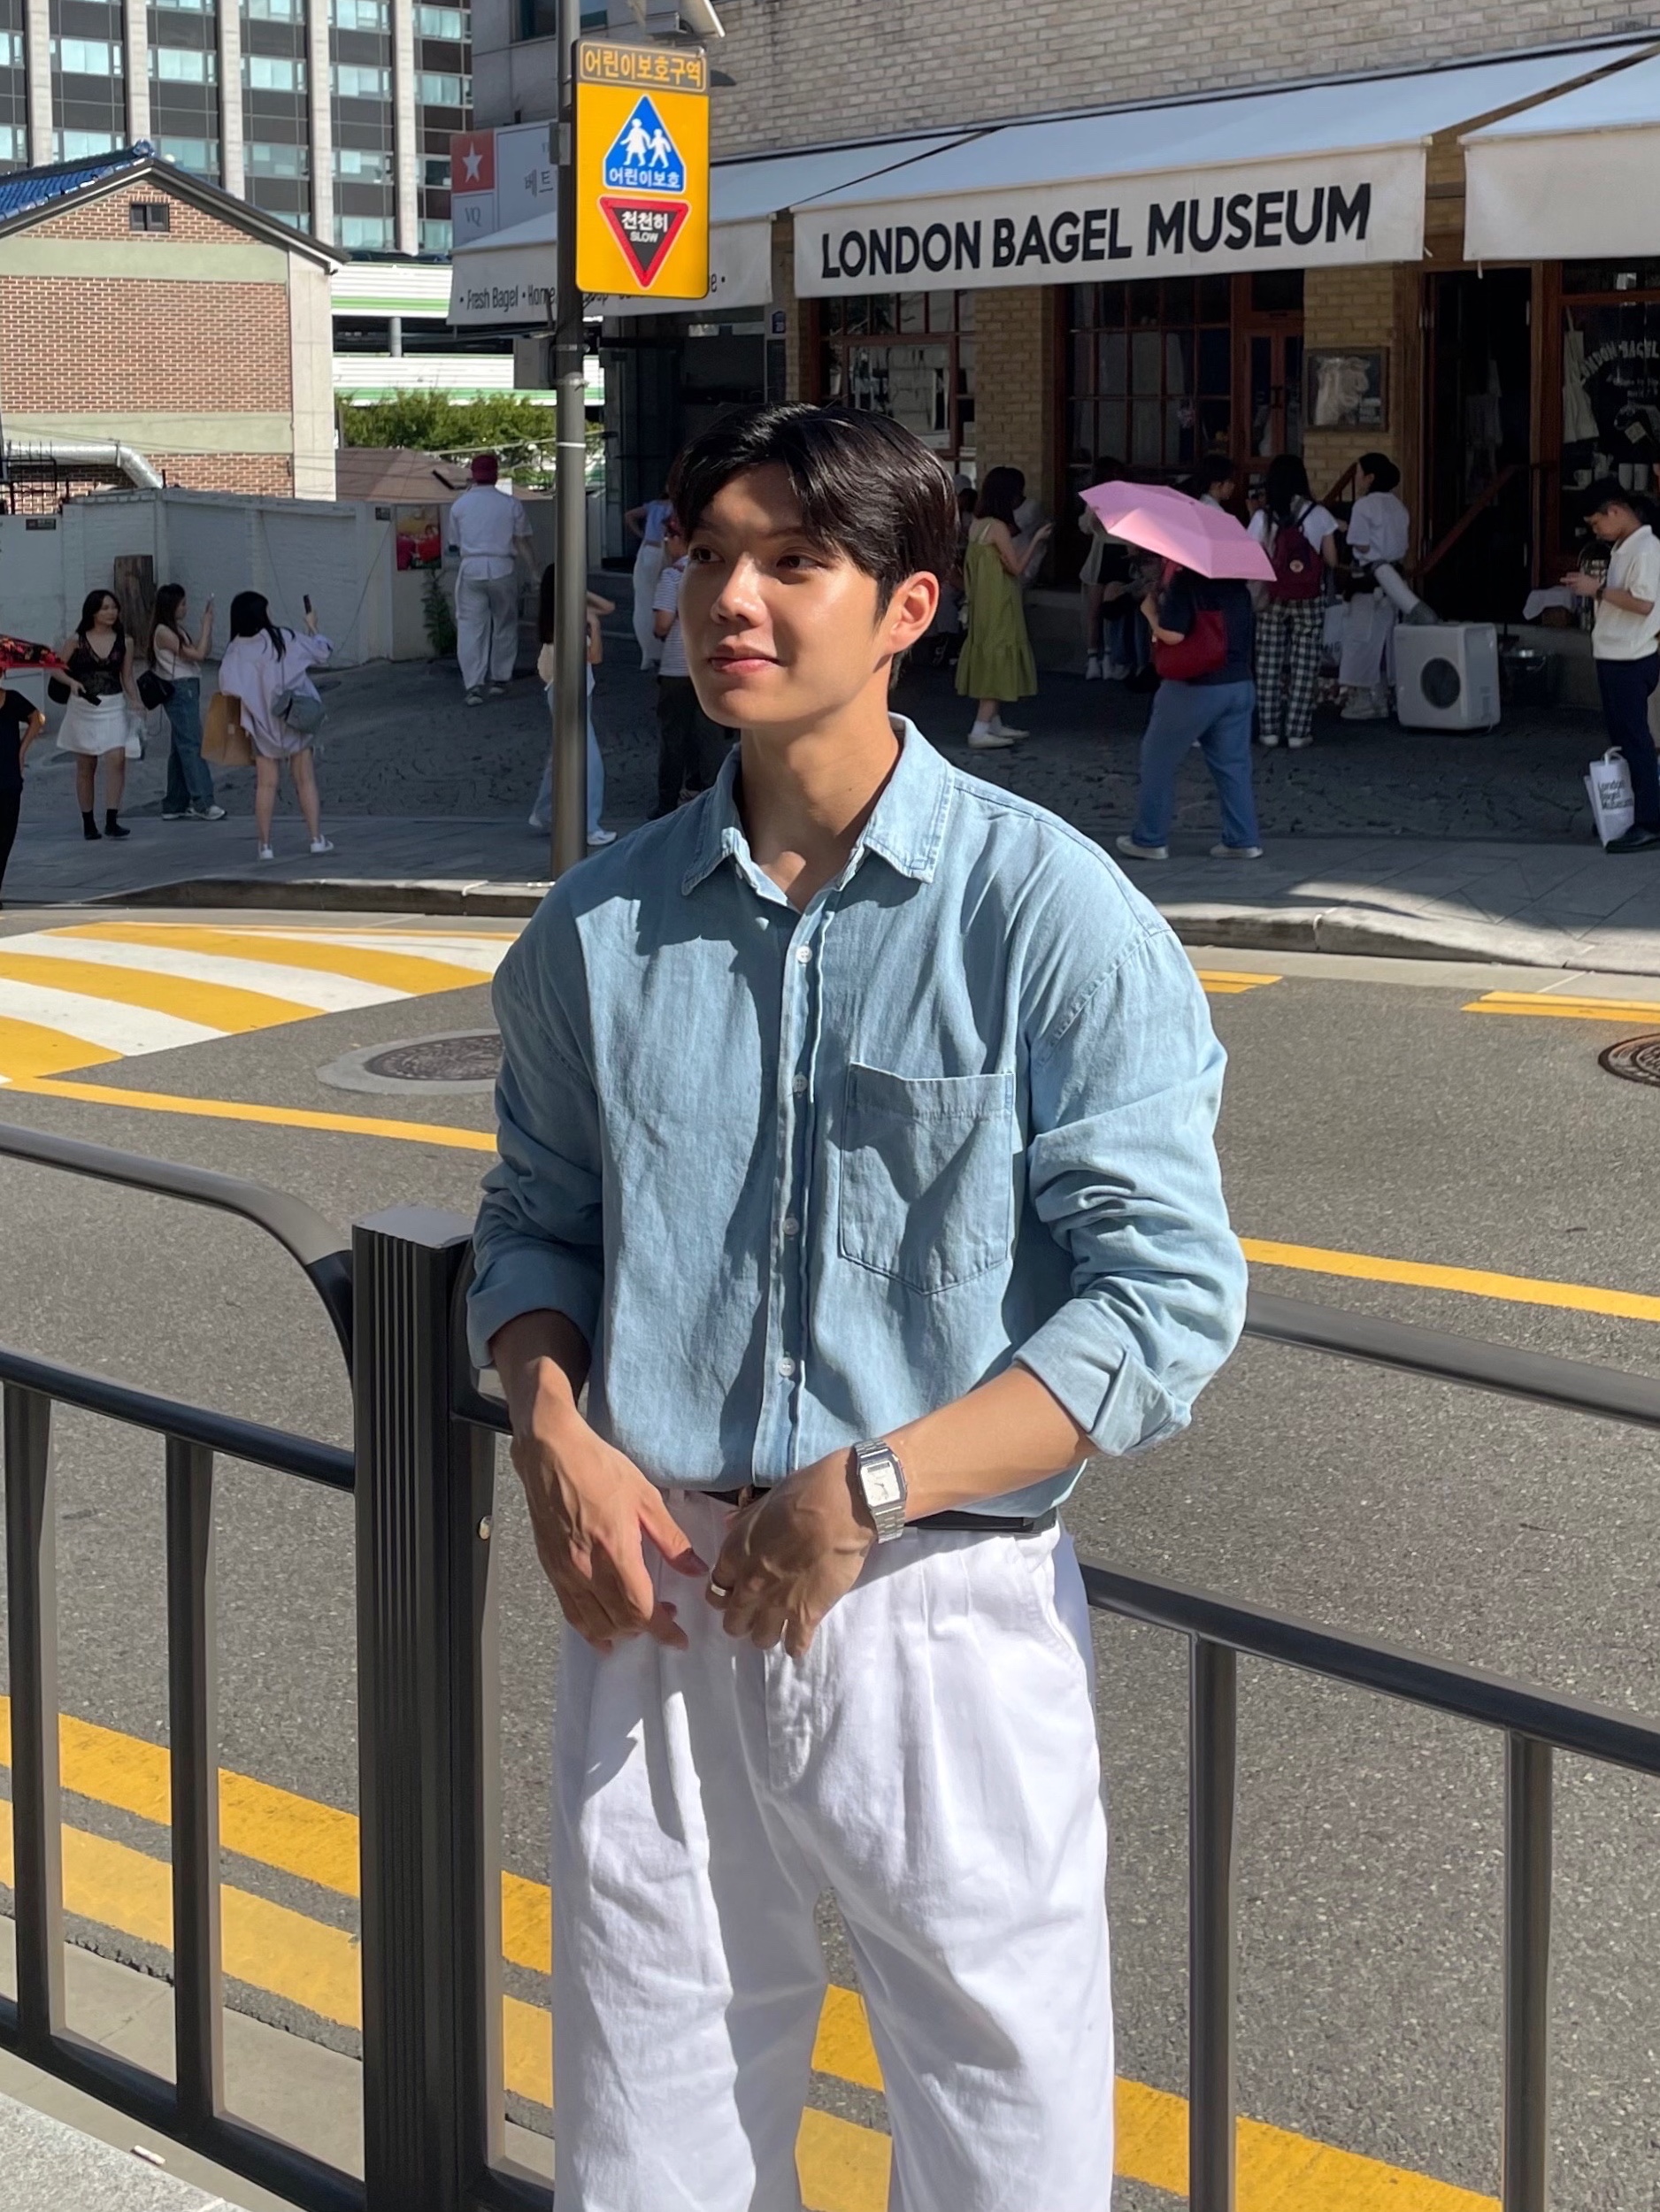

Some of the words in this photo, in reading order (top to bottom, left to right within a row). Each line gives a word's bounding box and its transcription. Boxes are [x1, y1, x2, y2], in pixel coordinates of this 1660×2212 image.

[584, 48, 702, 88] 어린이보호구역
[609, 166, 681, 188] 어린이보호
[621, 211, 668, 233] 천천히
[821, 220, 981, 279] LONDON
[992, 207, 1134, 268] BAGEL
[1147, 182, 1372, 257] MUSEUM
[630, 232, 658, 242] SLOW
[466, 287, 490, 311] Fresh
[492, 286, 519, 312] Bagel
